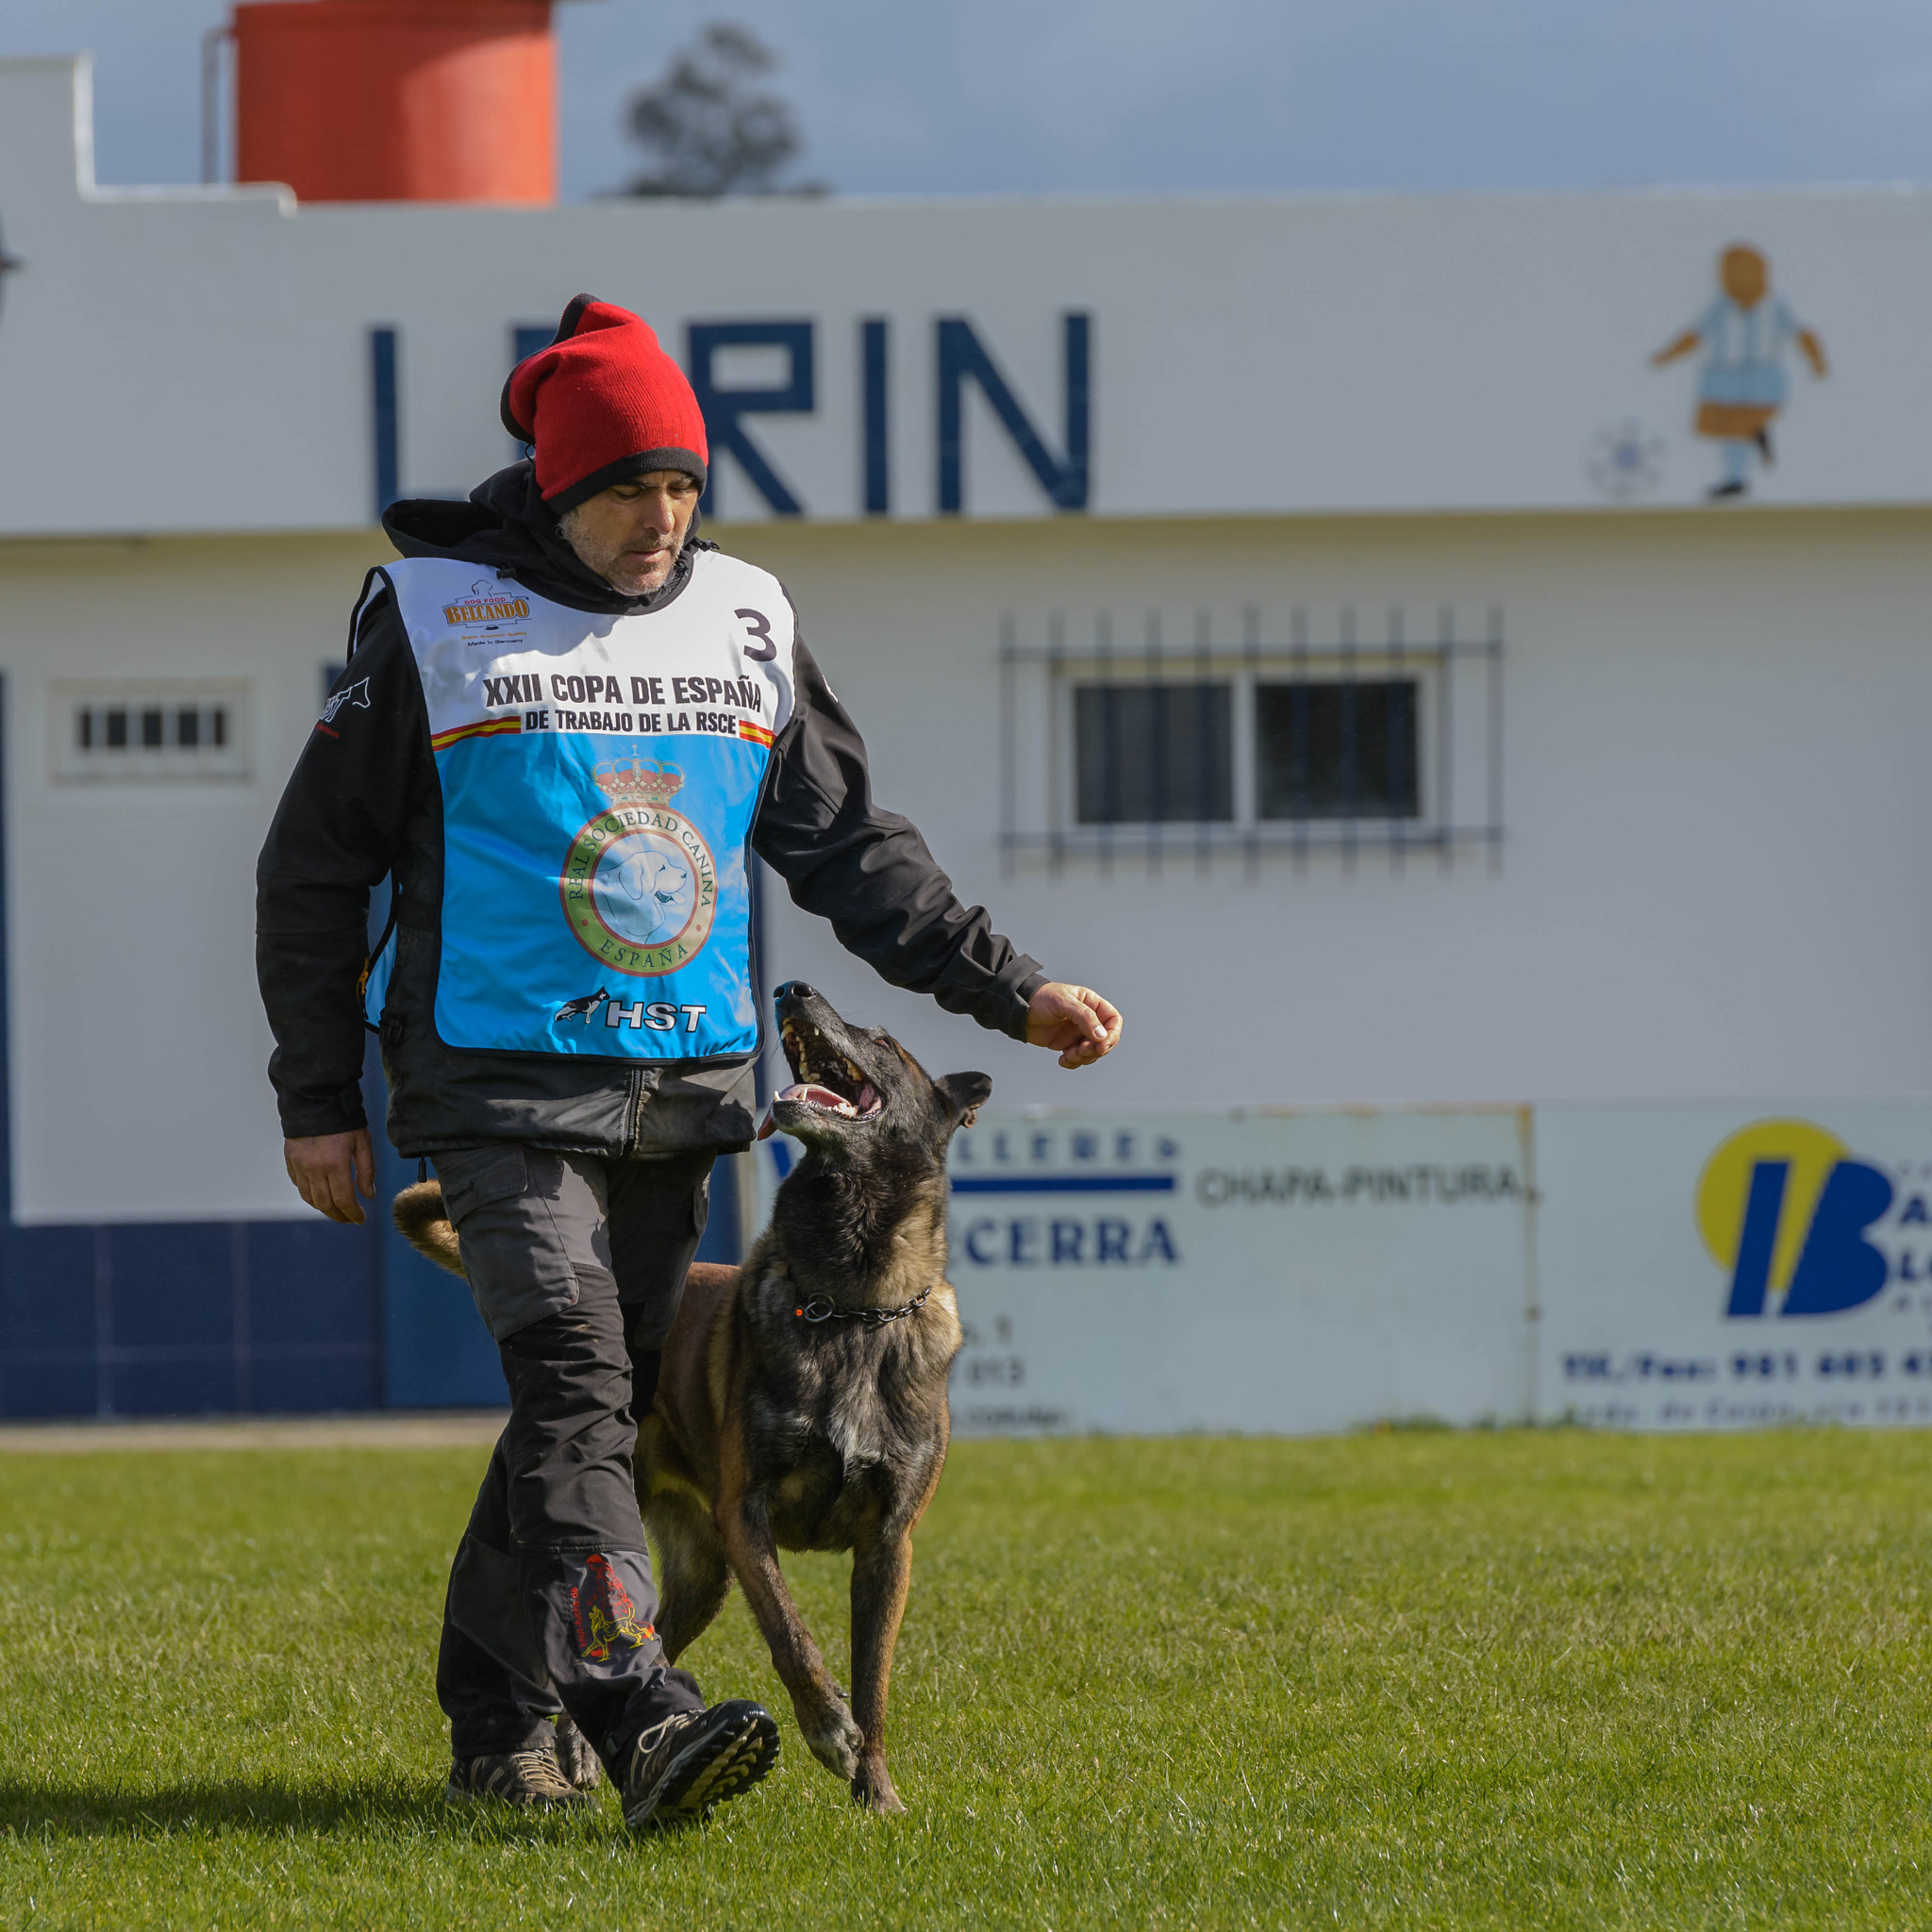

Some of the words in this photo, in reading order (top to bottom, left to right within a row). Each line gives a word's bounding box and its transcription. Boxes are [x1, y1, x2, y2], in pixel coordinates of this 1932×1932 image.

[371, 313, 1091, 521] LRIN
[443, 598, 529, 625] BELCANDO
[734, 607, 777, 662] 3
[482, 673, 543, 708] XXII
[551, 673, 624, 705] COPA
[631, 676, 664, 705] DE
[672, 675, 761, 713] ESPAÑA
[525, 709, 549, 730] DE
[555, 709, 633, 733] TRABAJO
[638, 712, 661, 733] DE
[667, 712, 691, 732] LA
[695, 711, 737, 735] RSCE
[569, 855, 591, 901] REAL
[582, 811, 679, 852] SOCIEDAD
[682, 830, 714, 908] CANINA
[599, 938, 689, 968] ESPAÑA
[605, 1000, 707, 1034] HST
[955, 1129, 1177, 1162] LLERES
[958, 1215, 1179, 1266] CERRA
